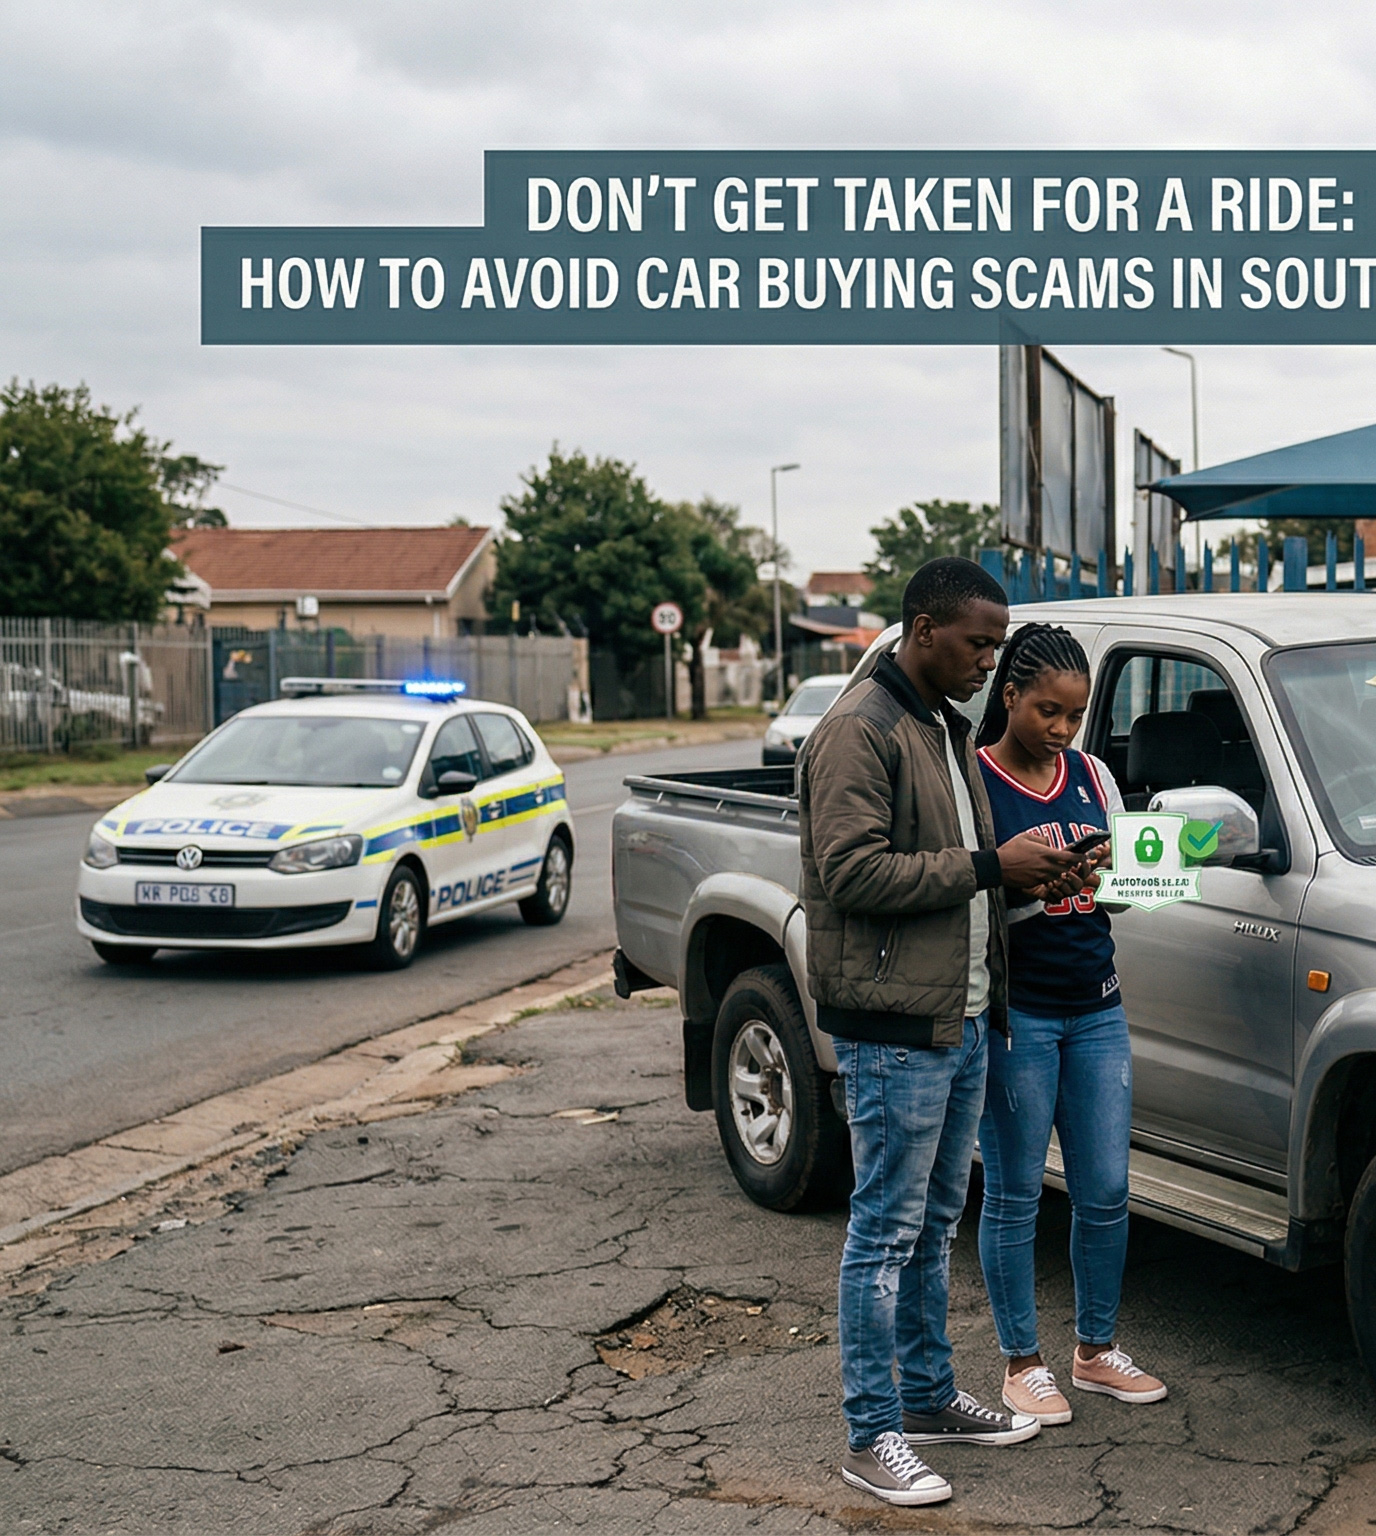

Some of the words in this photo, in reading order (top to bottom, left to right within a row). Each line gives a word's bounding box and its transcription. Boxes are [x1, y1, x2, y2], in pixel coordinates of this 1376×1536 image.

[135, 818, 275, 839] POLICE
[437, 869, 507, 909] POLICE
[1234, 920, 1280, 942] HILUX
